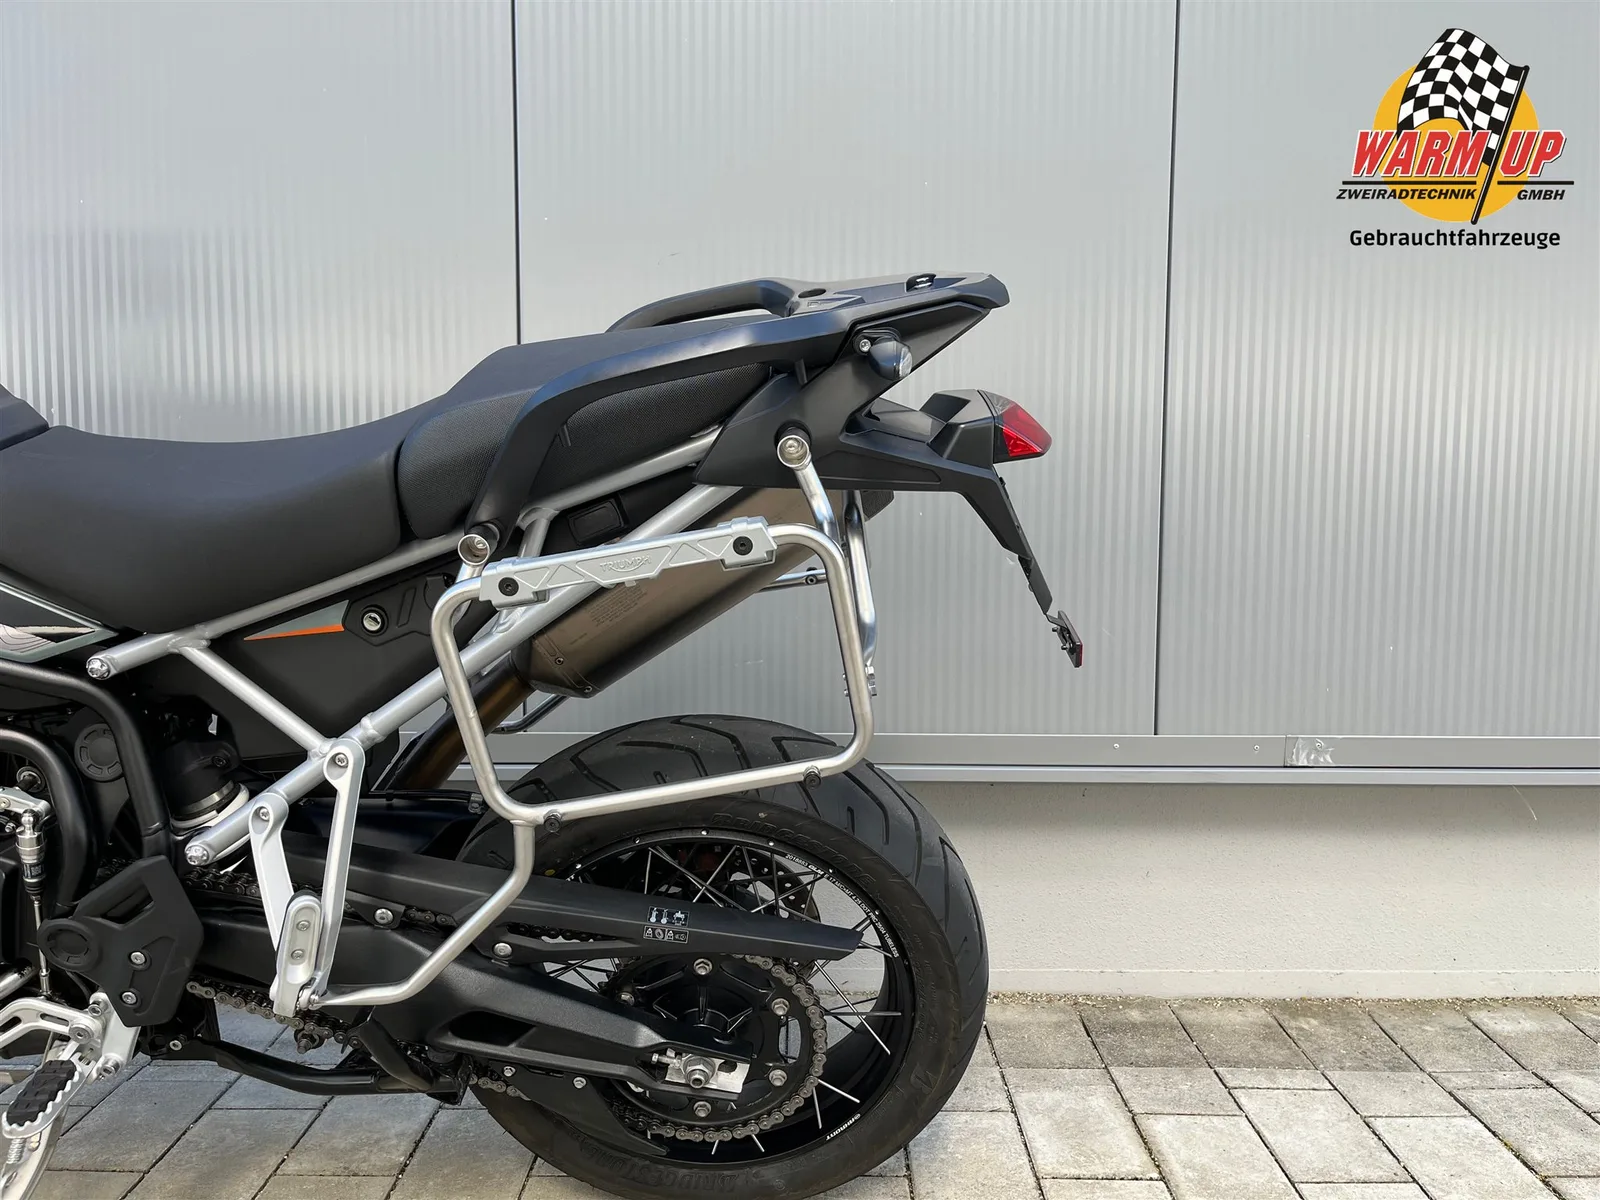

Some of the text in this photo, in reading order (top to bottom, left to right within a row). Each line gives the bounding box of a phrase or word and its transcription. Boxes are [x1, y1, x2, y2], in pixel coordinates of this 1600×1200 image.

[600, 555, 651, 572] TRIUMPH
[710, 812, 877, 887] BRIDGESTONE
[883, 933, 900, 958] TUBELESS
